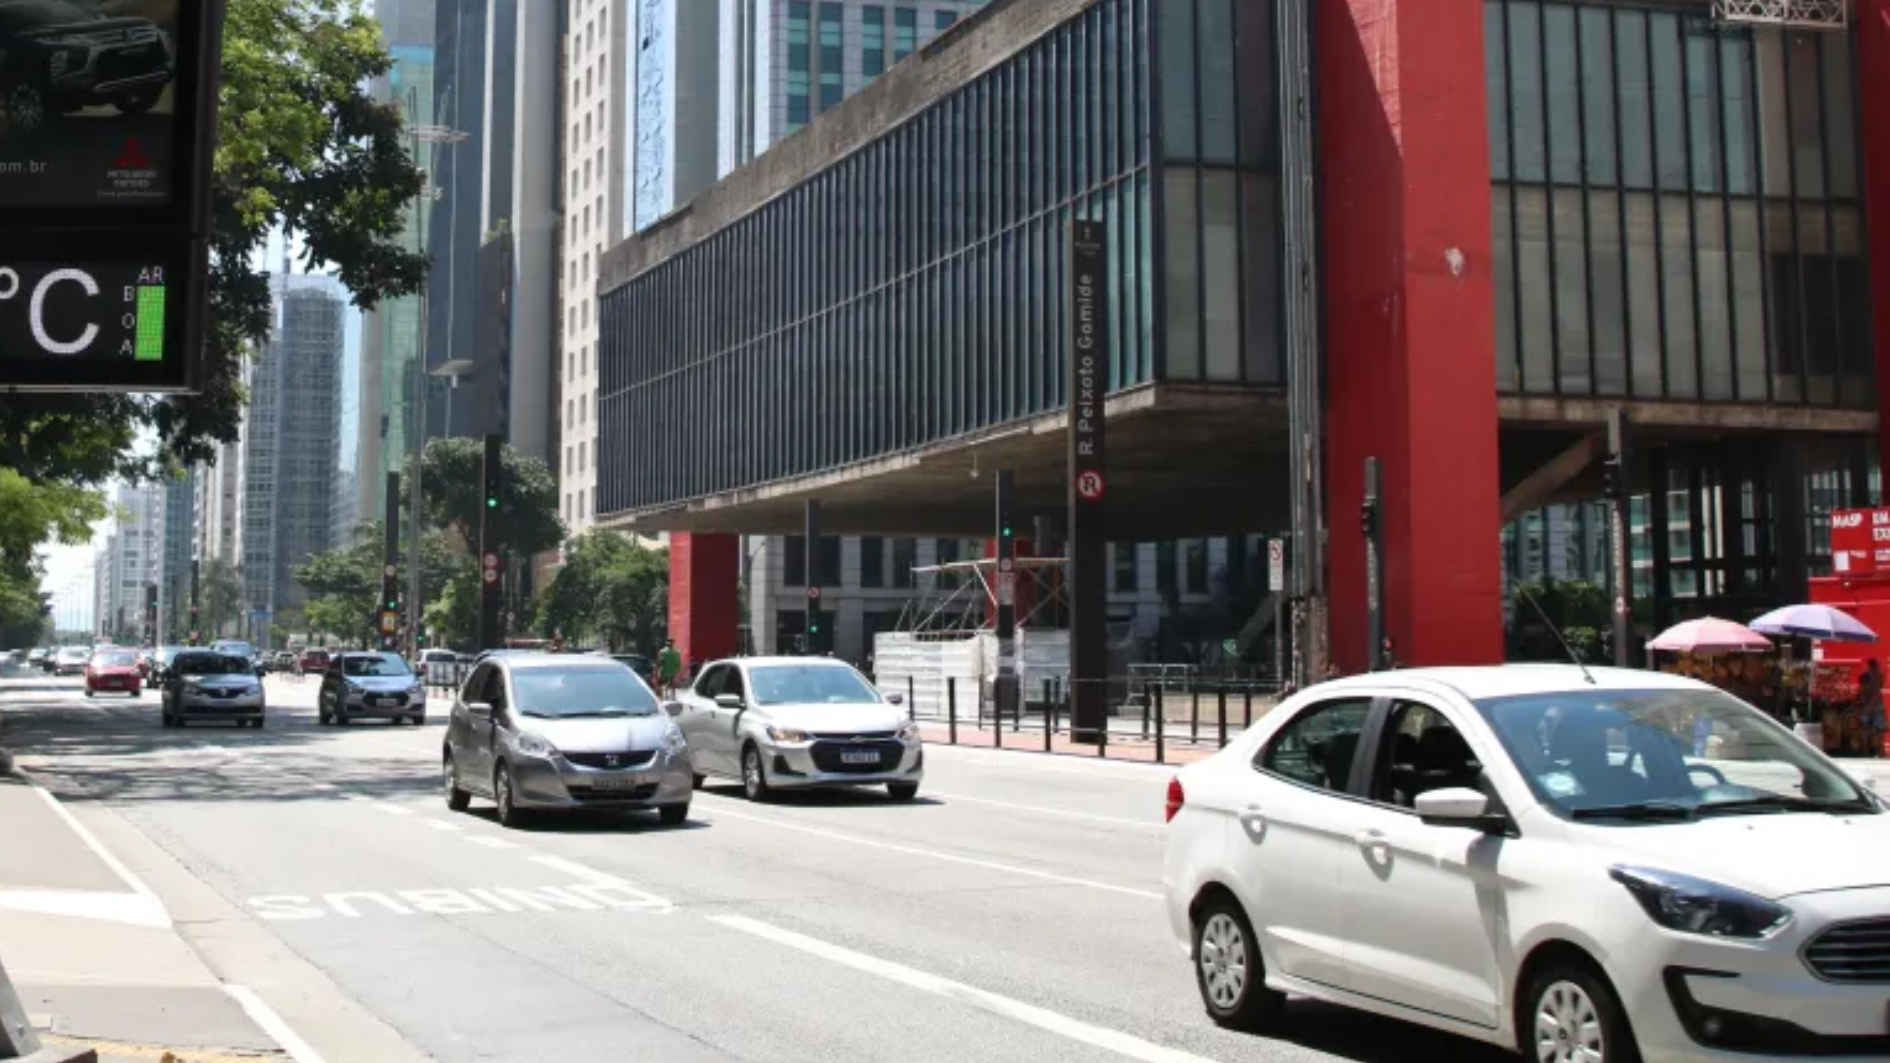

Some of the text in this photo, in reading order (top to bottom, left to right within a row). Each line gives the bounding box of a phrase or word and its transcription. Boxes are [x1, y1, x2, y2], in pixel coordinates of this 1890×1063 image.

[137, 266, 164, 283] AR
[1078, 273, 1093, 348] Gomide
[1078, 355, 1093, 432] Peixoto
